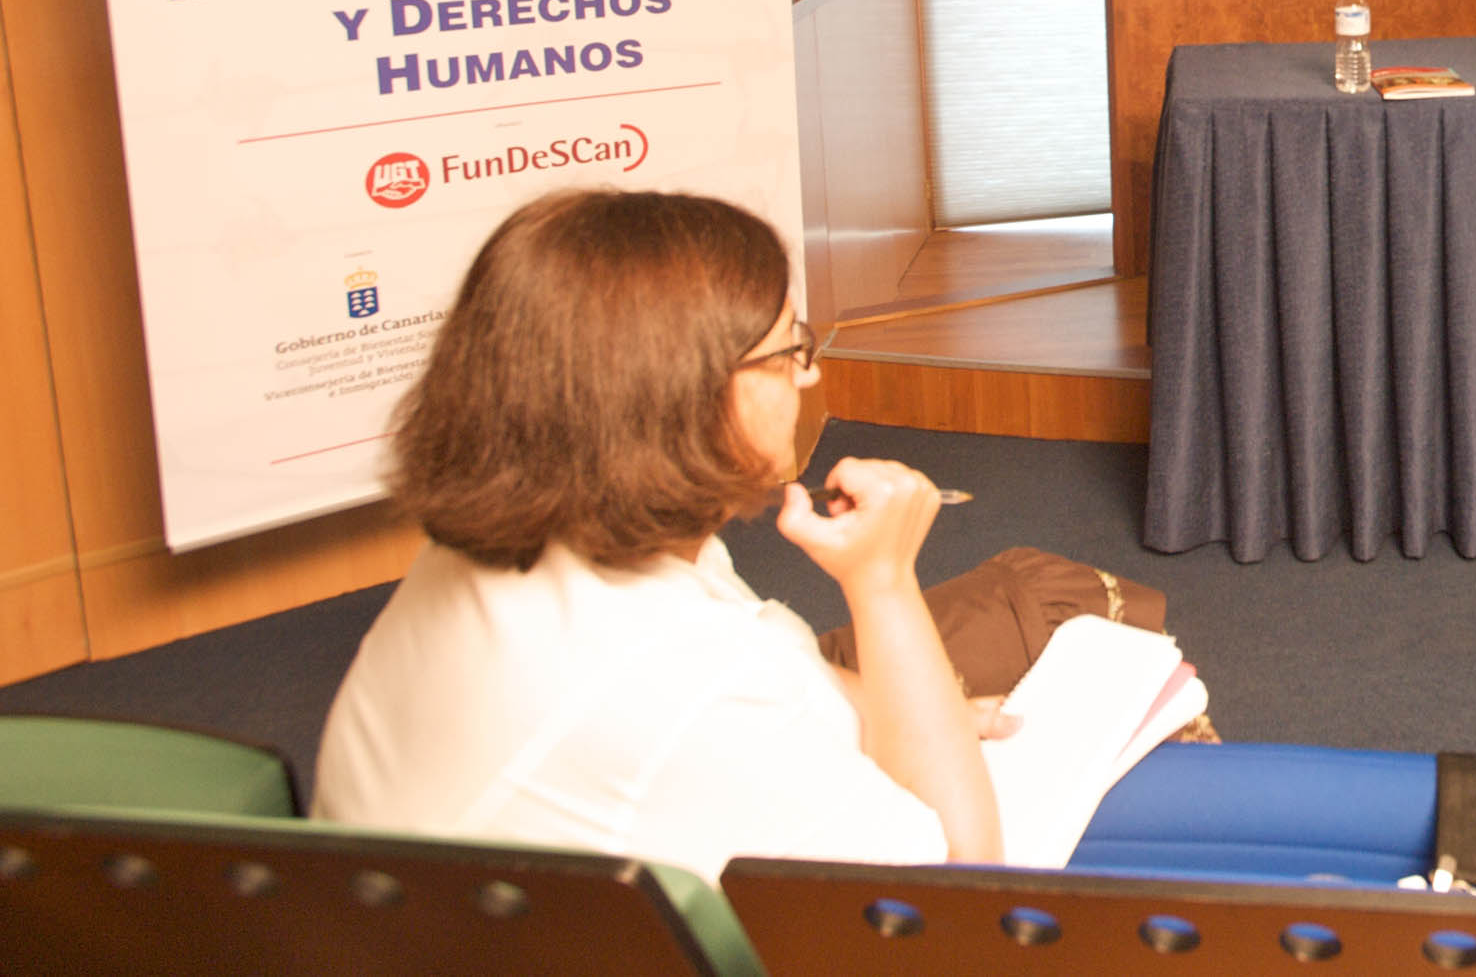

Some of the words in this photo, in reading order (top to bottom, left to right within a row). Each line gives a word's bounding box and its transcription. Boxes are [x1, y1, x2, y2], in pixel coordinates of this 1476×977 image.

[334, 8, 369, 41] Y
[442, 137, 633, 184] FunDeSCan
[275, 329, 357, 355] Gobierno
[359, 324, 379, 337] de
